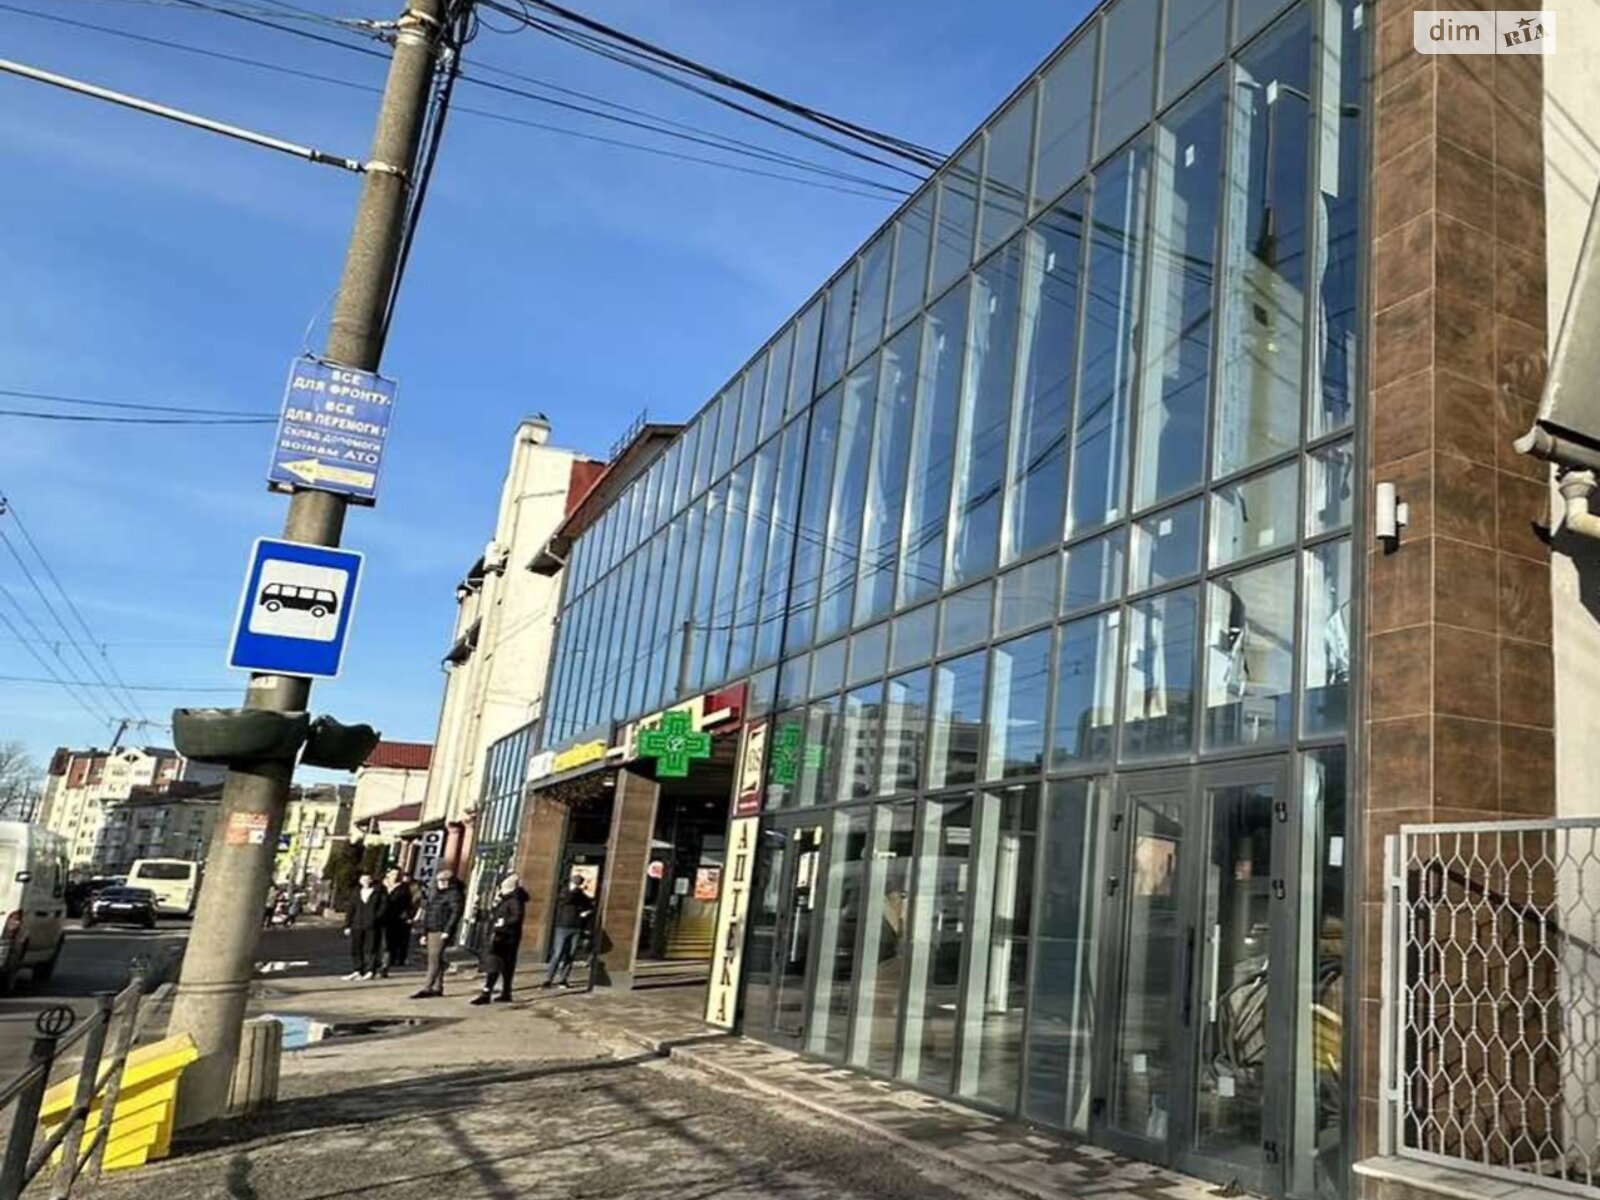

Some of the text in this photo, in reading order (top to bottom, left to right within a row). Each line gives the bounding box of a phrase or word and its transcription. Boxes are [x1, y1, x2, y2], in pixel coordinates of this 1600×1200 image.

[292, 376, 325, 392] ДЛЯ
[331, 370, 361, 386] ВСЕ
[285, 407, 313, 423] ДЛЯ
[325, 401, 355, 416] ВСЕ
[344, 450, 378, 464] АТО
[715, 821, 748, 1022] АПТЕКА
